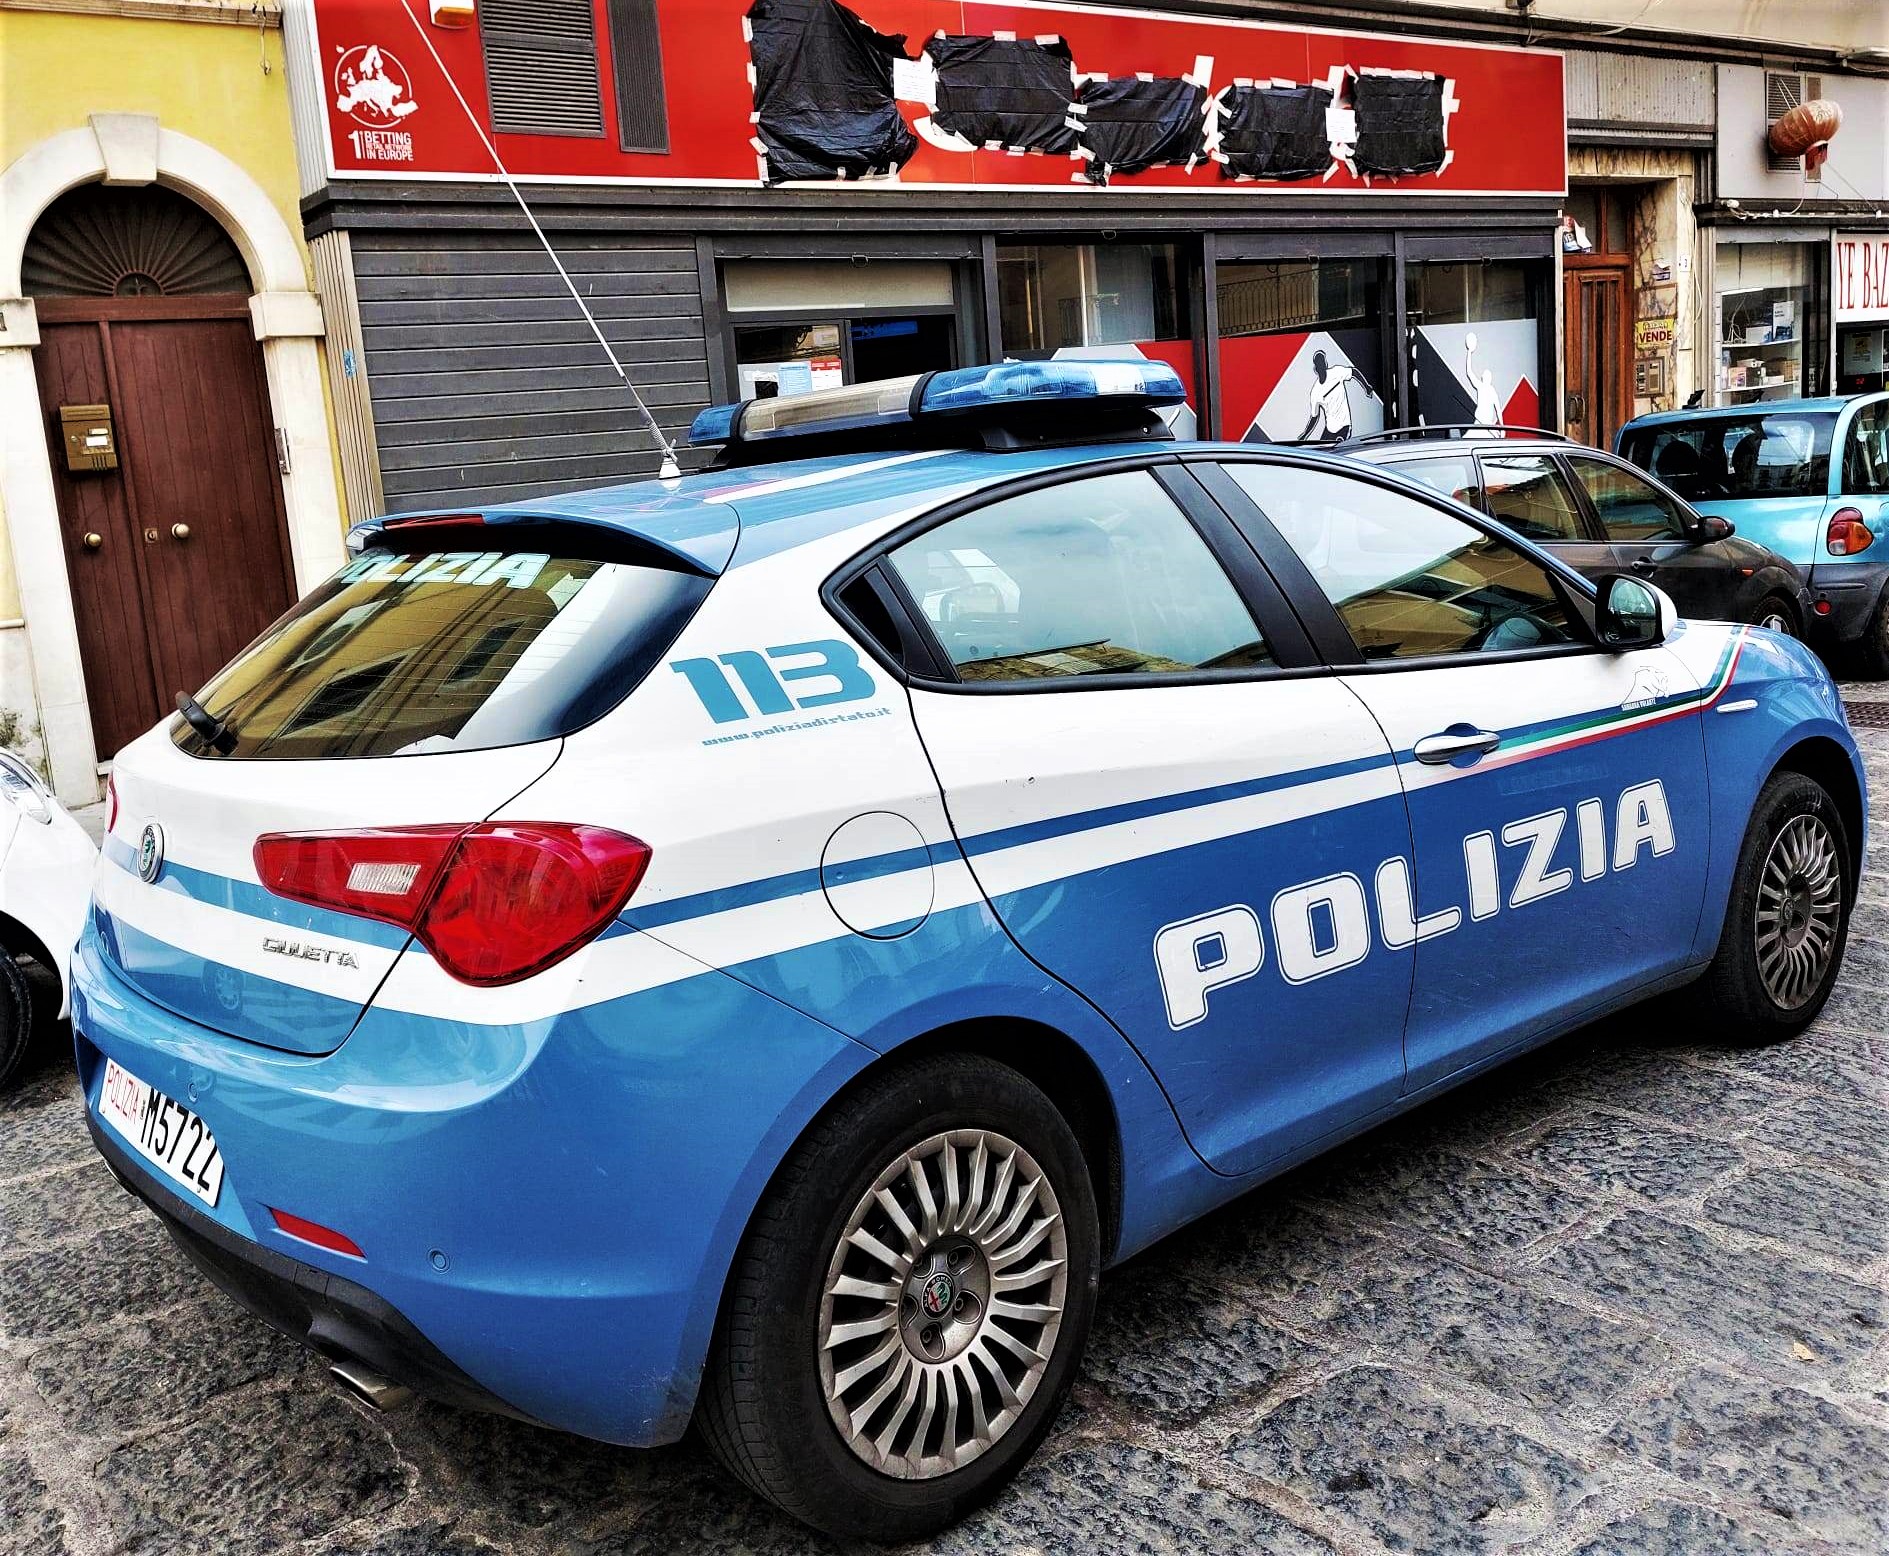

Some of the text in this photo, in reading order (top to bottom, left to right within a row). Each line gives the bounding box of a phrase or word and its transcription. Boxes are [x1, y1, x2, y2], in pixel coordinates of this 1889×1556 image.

[364, 131, 412, 145] BETTING
[367, 149, 414, 161] IN EUROPE
[1837, 242, 1855, 309] YE
[1639, 330, 1672, 343] VENDE
[669, 639, 876, 724] 113
[1153, 778, 1676, 1032] POLIZIA
[106, 1063, 139, 1124] POLIZIA
[141, 1087, 217, 1192] M5722
